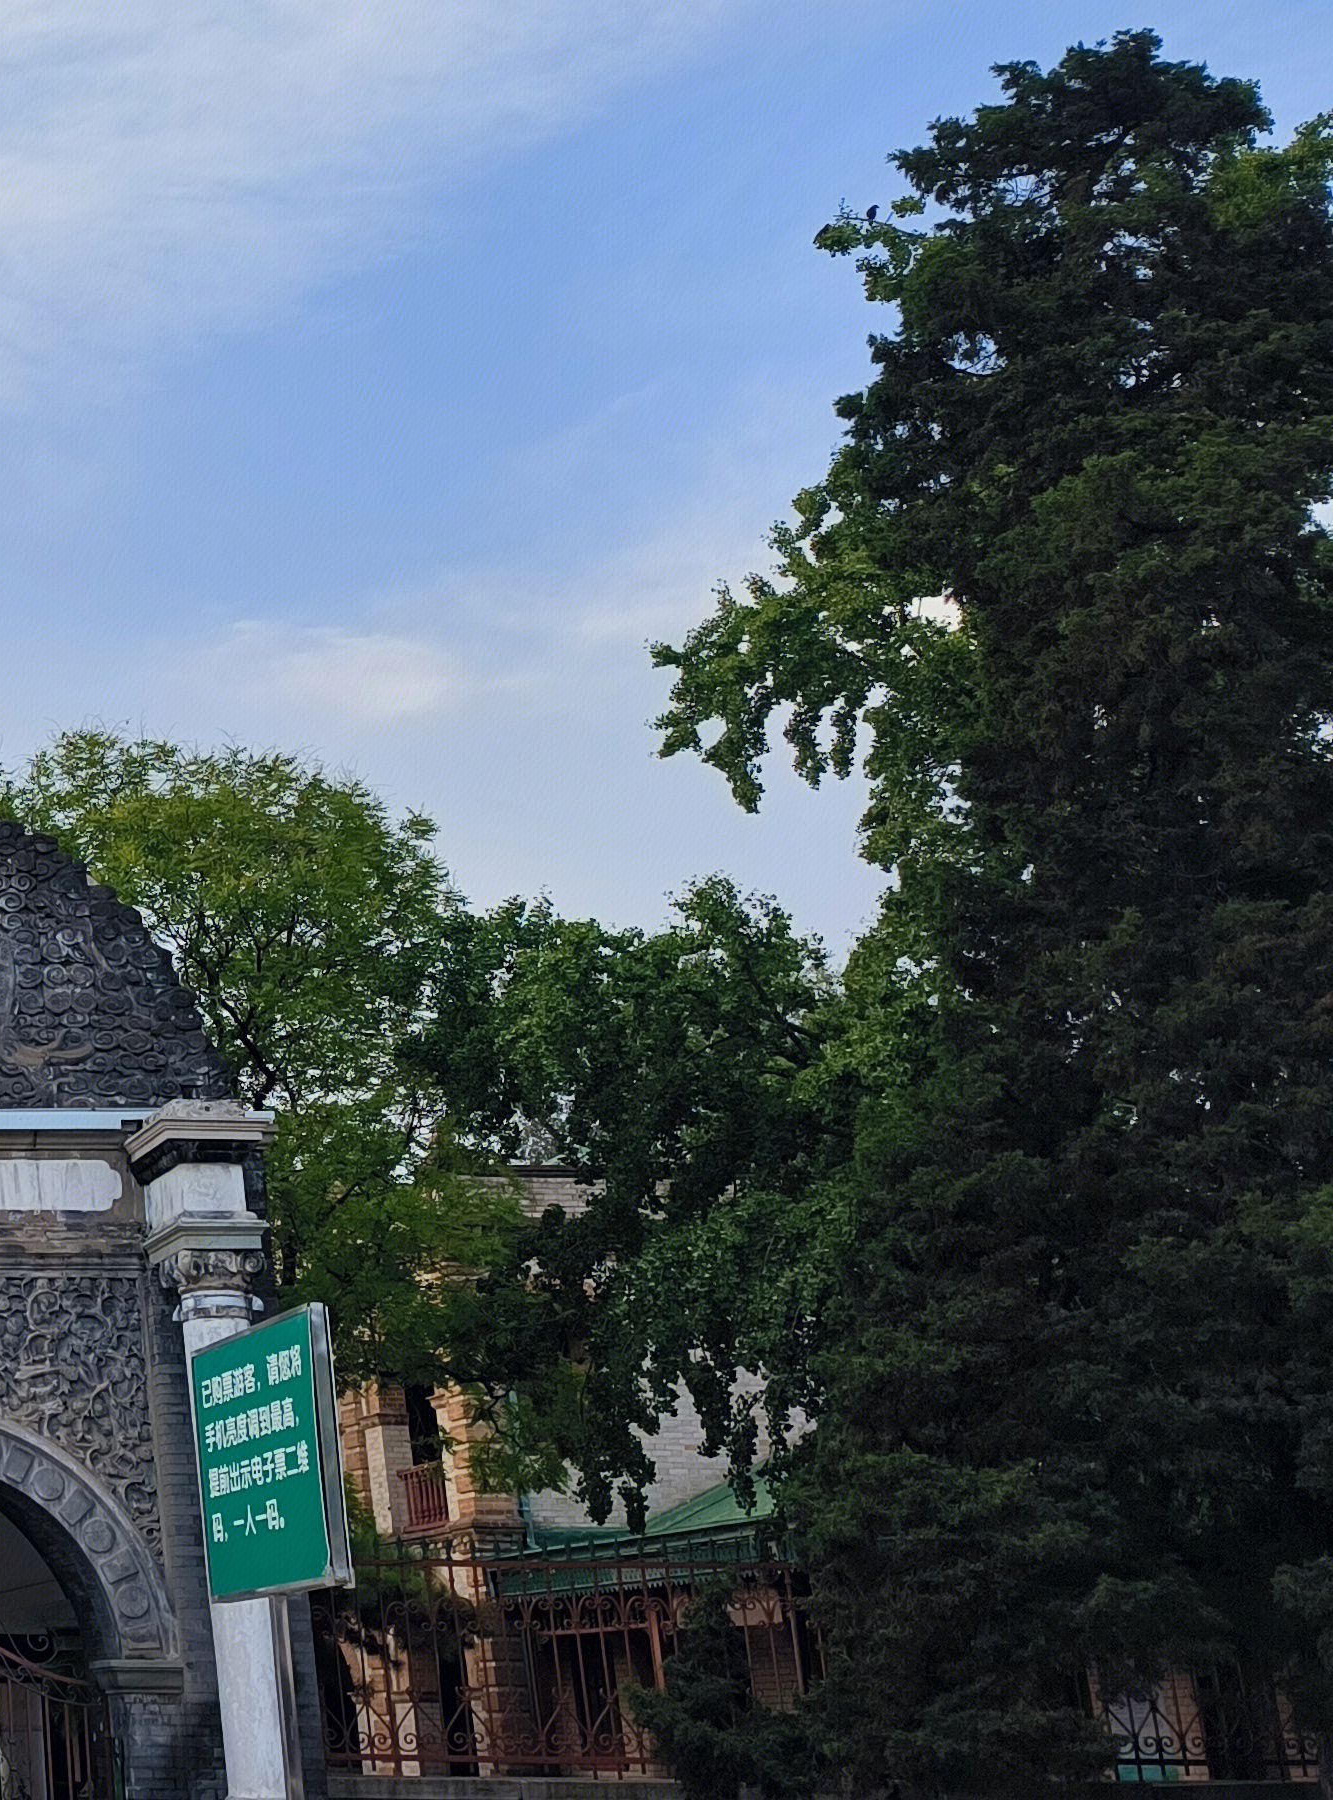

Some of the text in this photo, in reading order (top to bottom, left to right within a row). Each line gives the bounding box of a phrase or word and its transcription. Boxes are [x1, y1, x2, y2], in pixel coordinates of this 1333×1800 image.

[201, 1344, 302, 1409] 已购票游客，请您将
[204, 1396, 300, 1453] 手机亮度调到最高，
[208, 1439, 310, 1499] 提前出示电子票二维
[211, 1498, 285, 1543] 码，一人一码。
